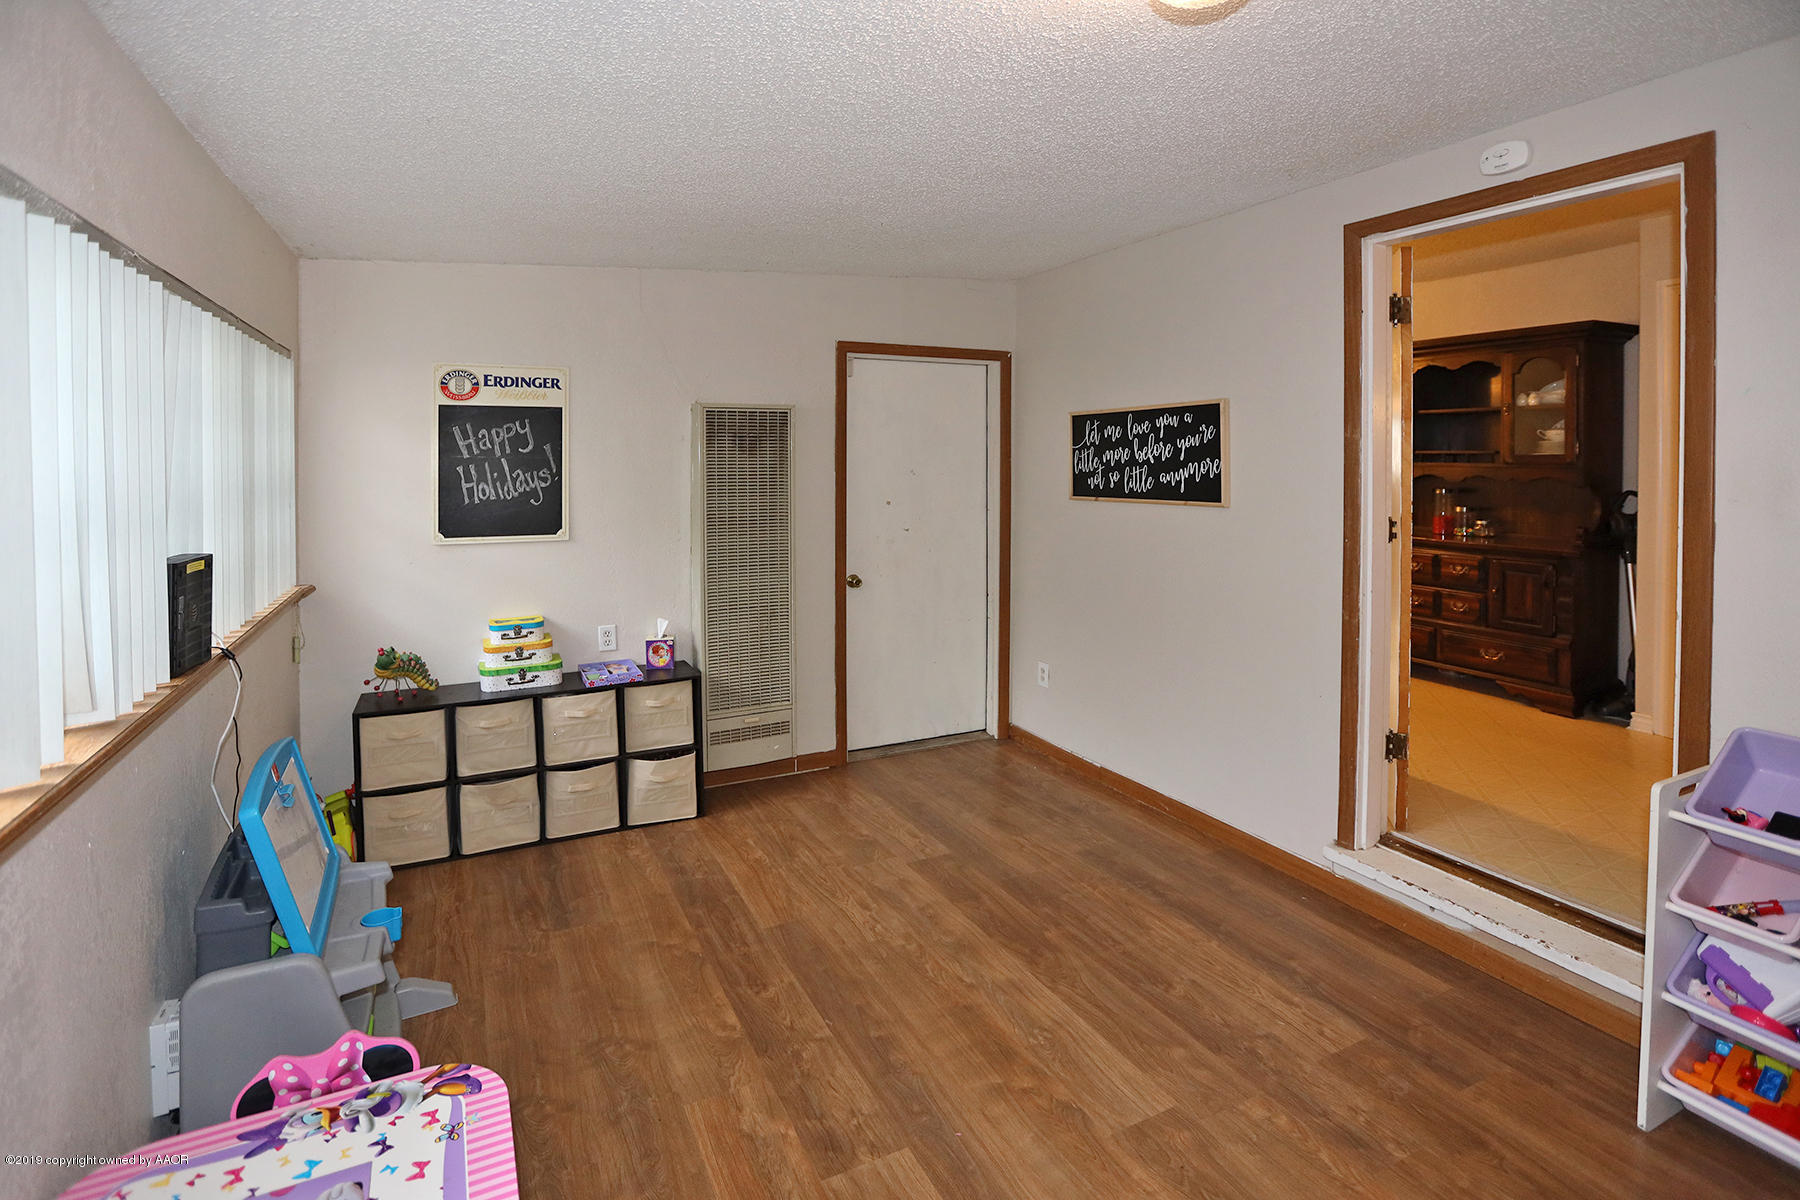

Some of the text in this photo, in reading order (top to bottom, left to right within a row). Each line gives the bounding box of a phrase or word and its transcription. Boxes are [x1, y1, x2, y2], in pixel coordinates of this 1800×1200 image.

[442, 370, 477, 384] ERDINGER
[483, 374, 562, 390] ERDINGER
[452, 418, 534, 459] Happy
[1073, 412, 1193, 448] let me love you a
[1074, 424, 1216, 474] little more before you're
[456, 443, 559, 506] Holidays!
[1088, 457, 1221, 494] not so little anymore
